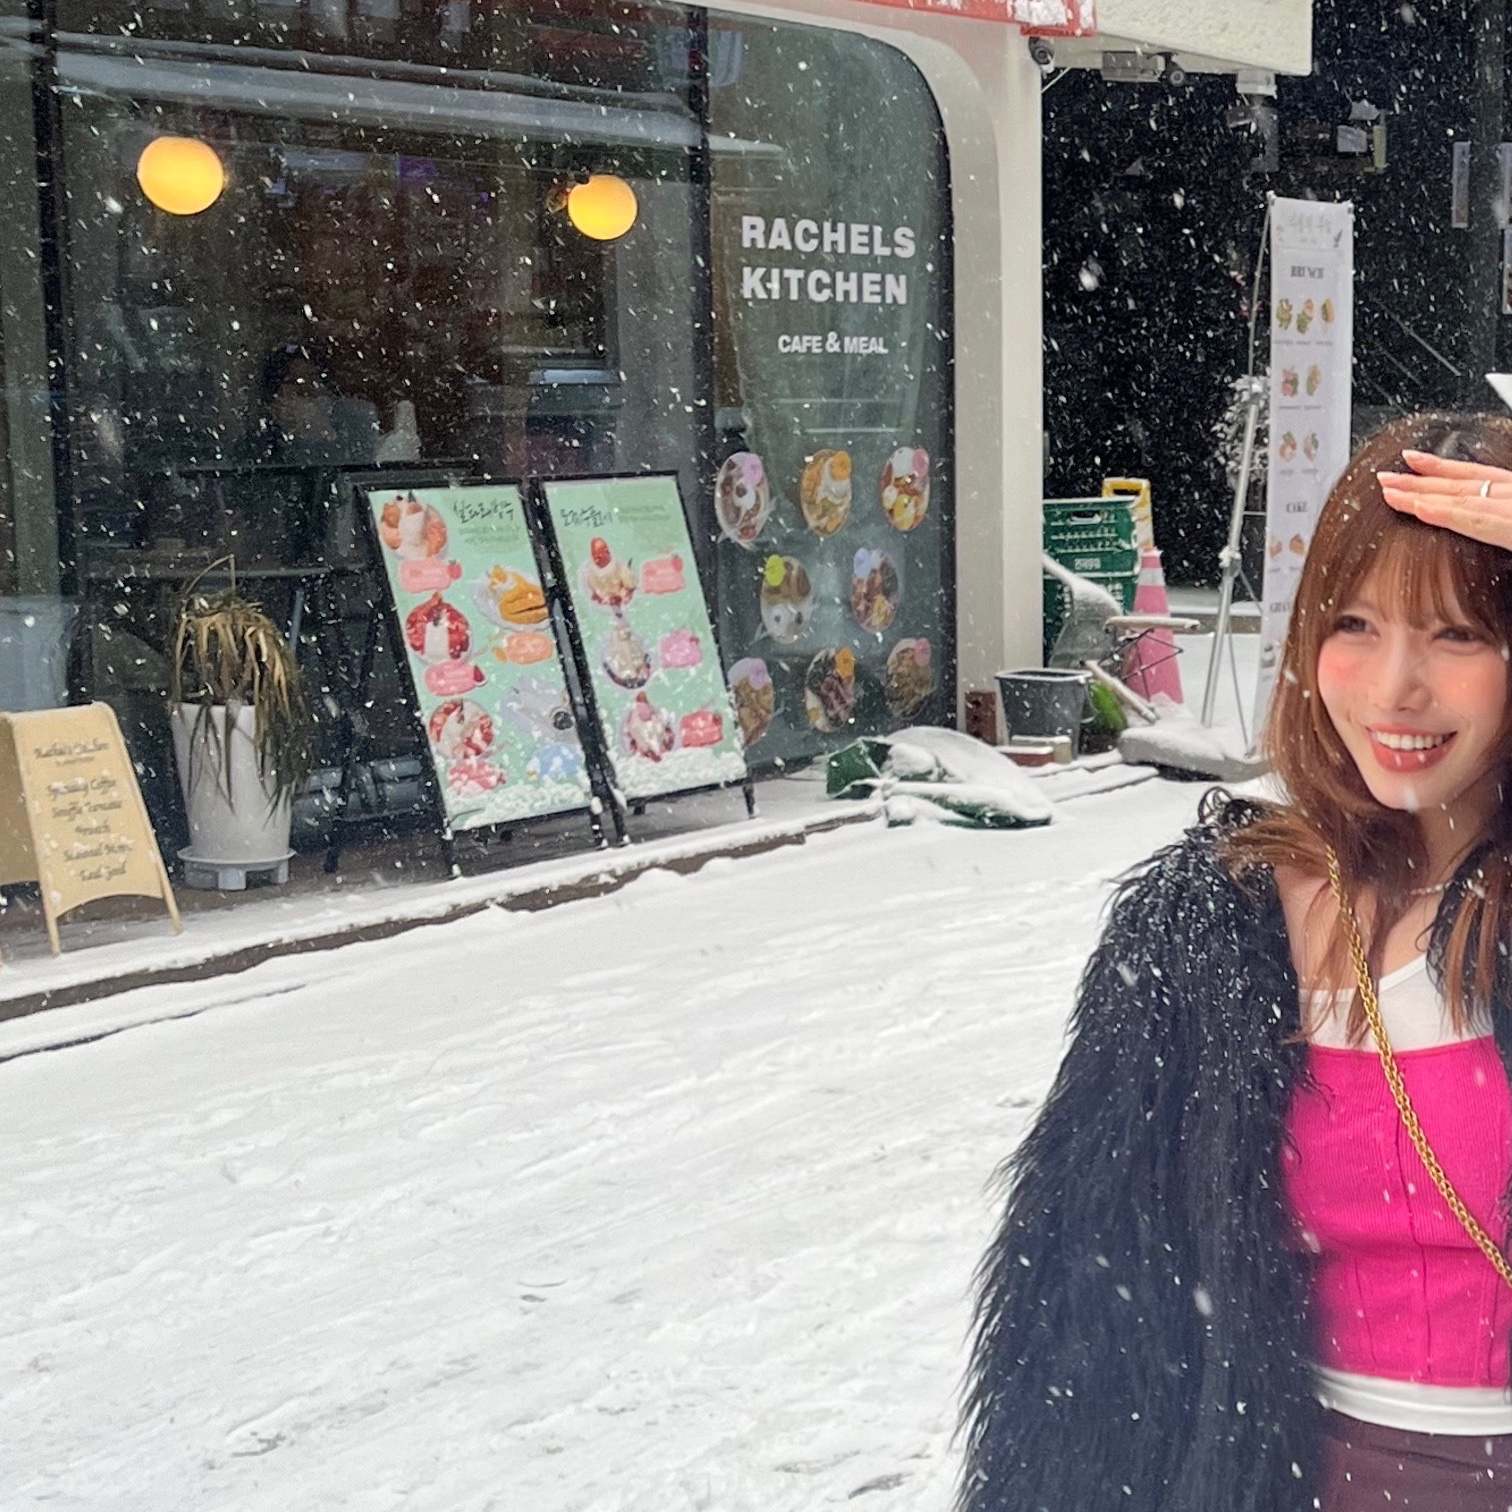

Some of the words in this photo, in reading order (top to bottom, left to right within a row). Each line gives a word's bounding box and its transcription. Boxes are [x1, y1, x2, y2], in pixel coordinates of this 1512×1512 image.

[741, 215, 916, 259] RACHELS
[742, 266, 908, 305] KITCHEN
[778, 334, 822, 353] CAFE
[825, 331, 841, 353] &
[844, 336, 889, 355] MEAL
